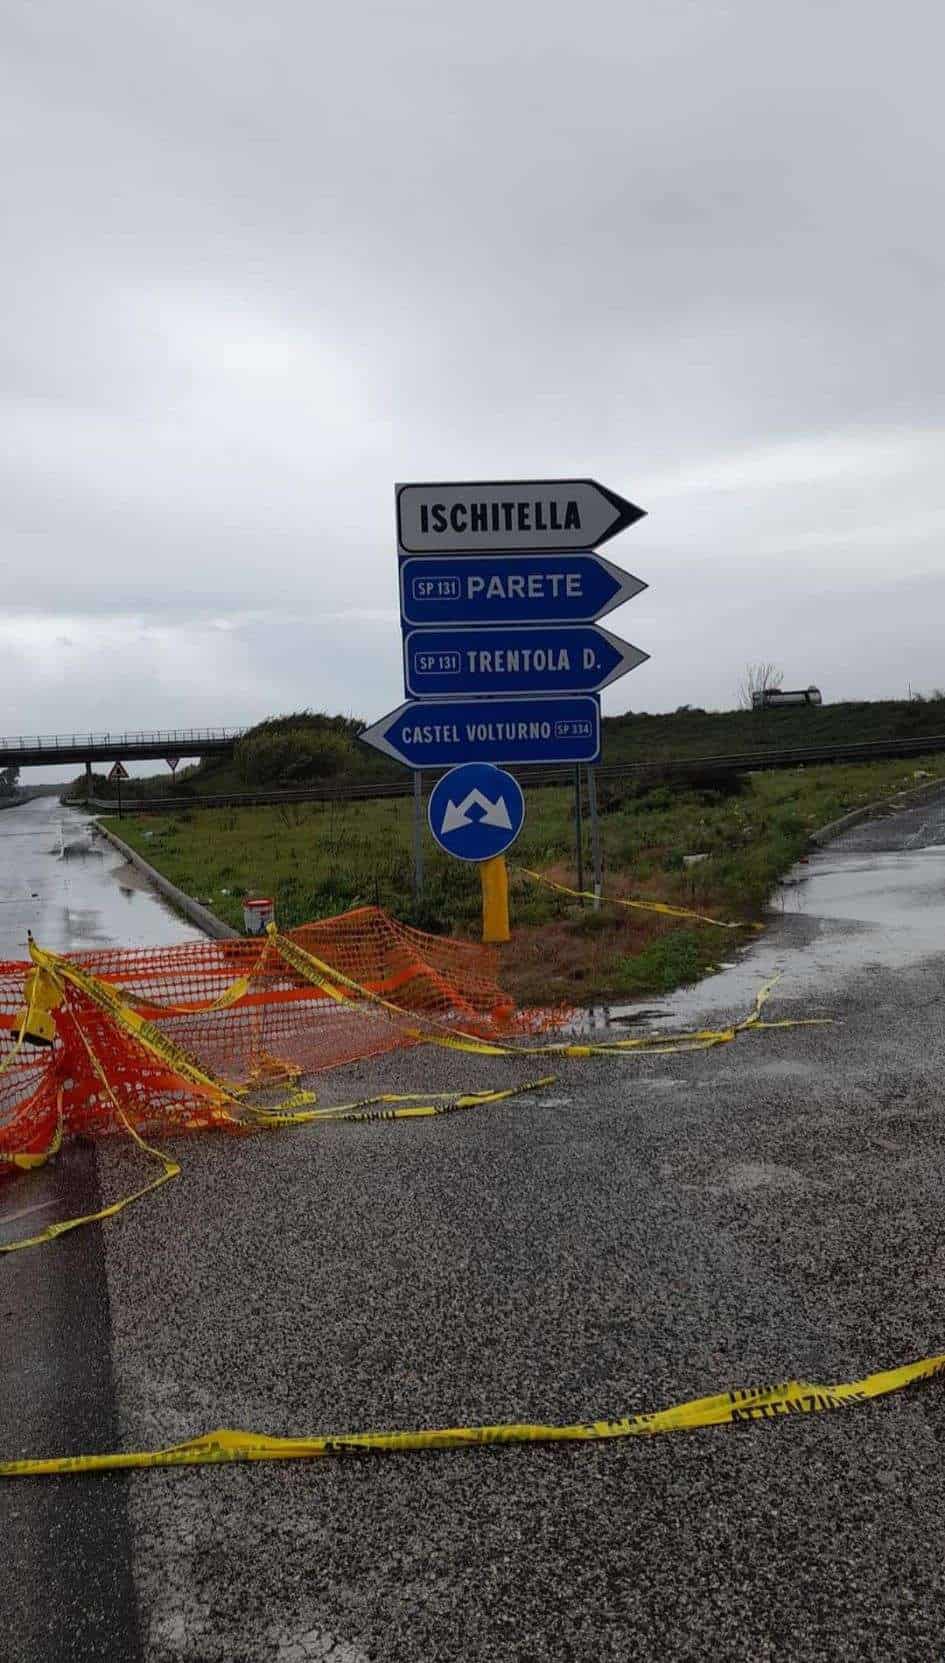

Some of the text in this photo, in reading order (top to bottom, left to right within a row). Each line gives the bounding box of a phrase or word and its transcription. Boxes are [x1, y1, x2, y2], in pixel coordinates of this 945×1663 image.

[420, 501, 582, 533] ISCHITELLA
[418, 581, 456, 596] SP 131
[466, 574, 583, 599] PARETE
[419, 655, 456, 671] SP 131
[467, 649, 601, 672] TRENTOLA D.
[402, 722, 550, 744] CASTEL VOLTURNO
[556, 722, 589, 736] SP 334
